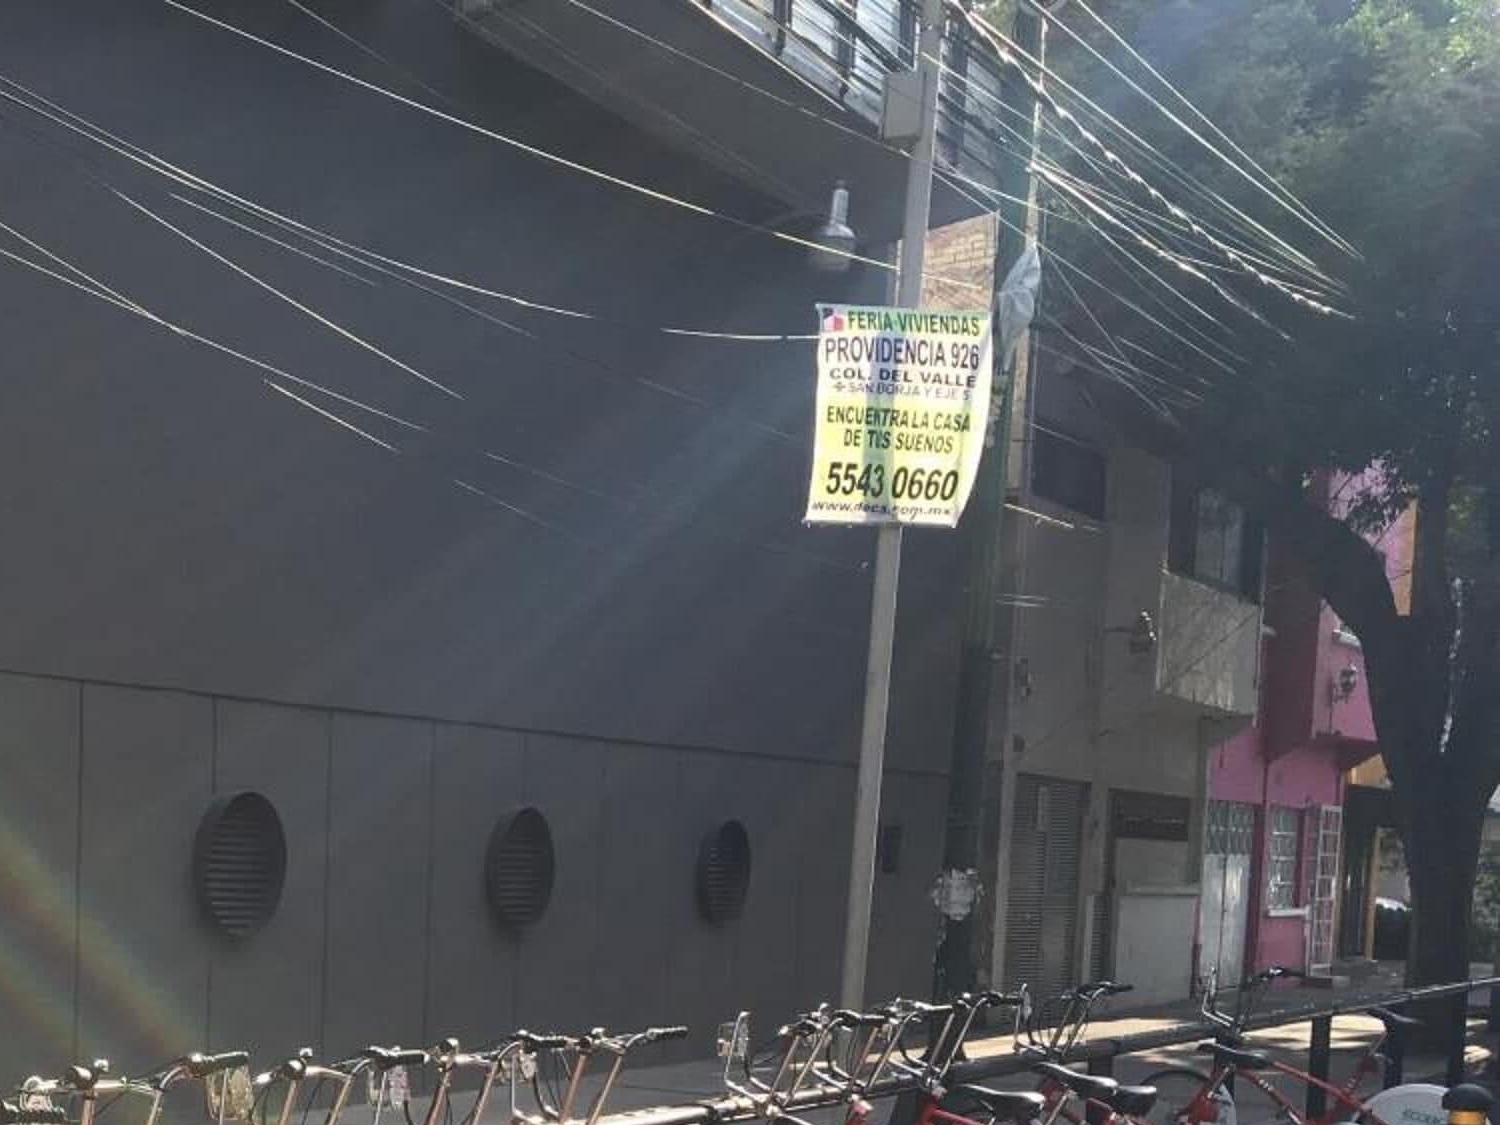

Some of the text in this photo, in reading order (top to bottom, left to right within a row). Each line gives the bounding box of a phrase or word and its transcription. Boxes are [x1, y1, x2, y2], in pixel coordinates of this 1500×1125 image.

[848, 311, 980, 337] FERIA VIVIENDAS
[825, 336, 979, 370] PROVIDENCIA 926
[829, 367, 977, 389] COL. DEL VALLE
[827, 405, 970, 432] ENCUENTRA LA CASA
[844, 429, 862, 447] DE
[826, 461, 959, 501] 5543 0660
